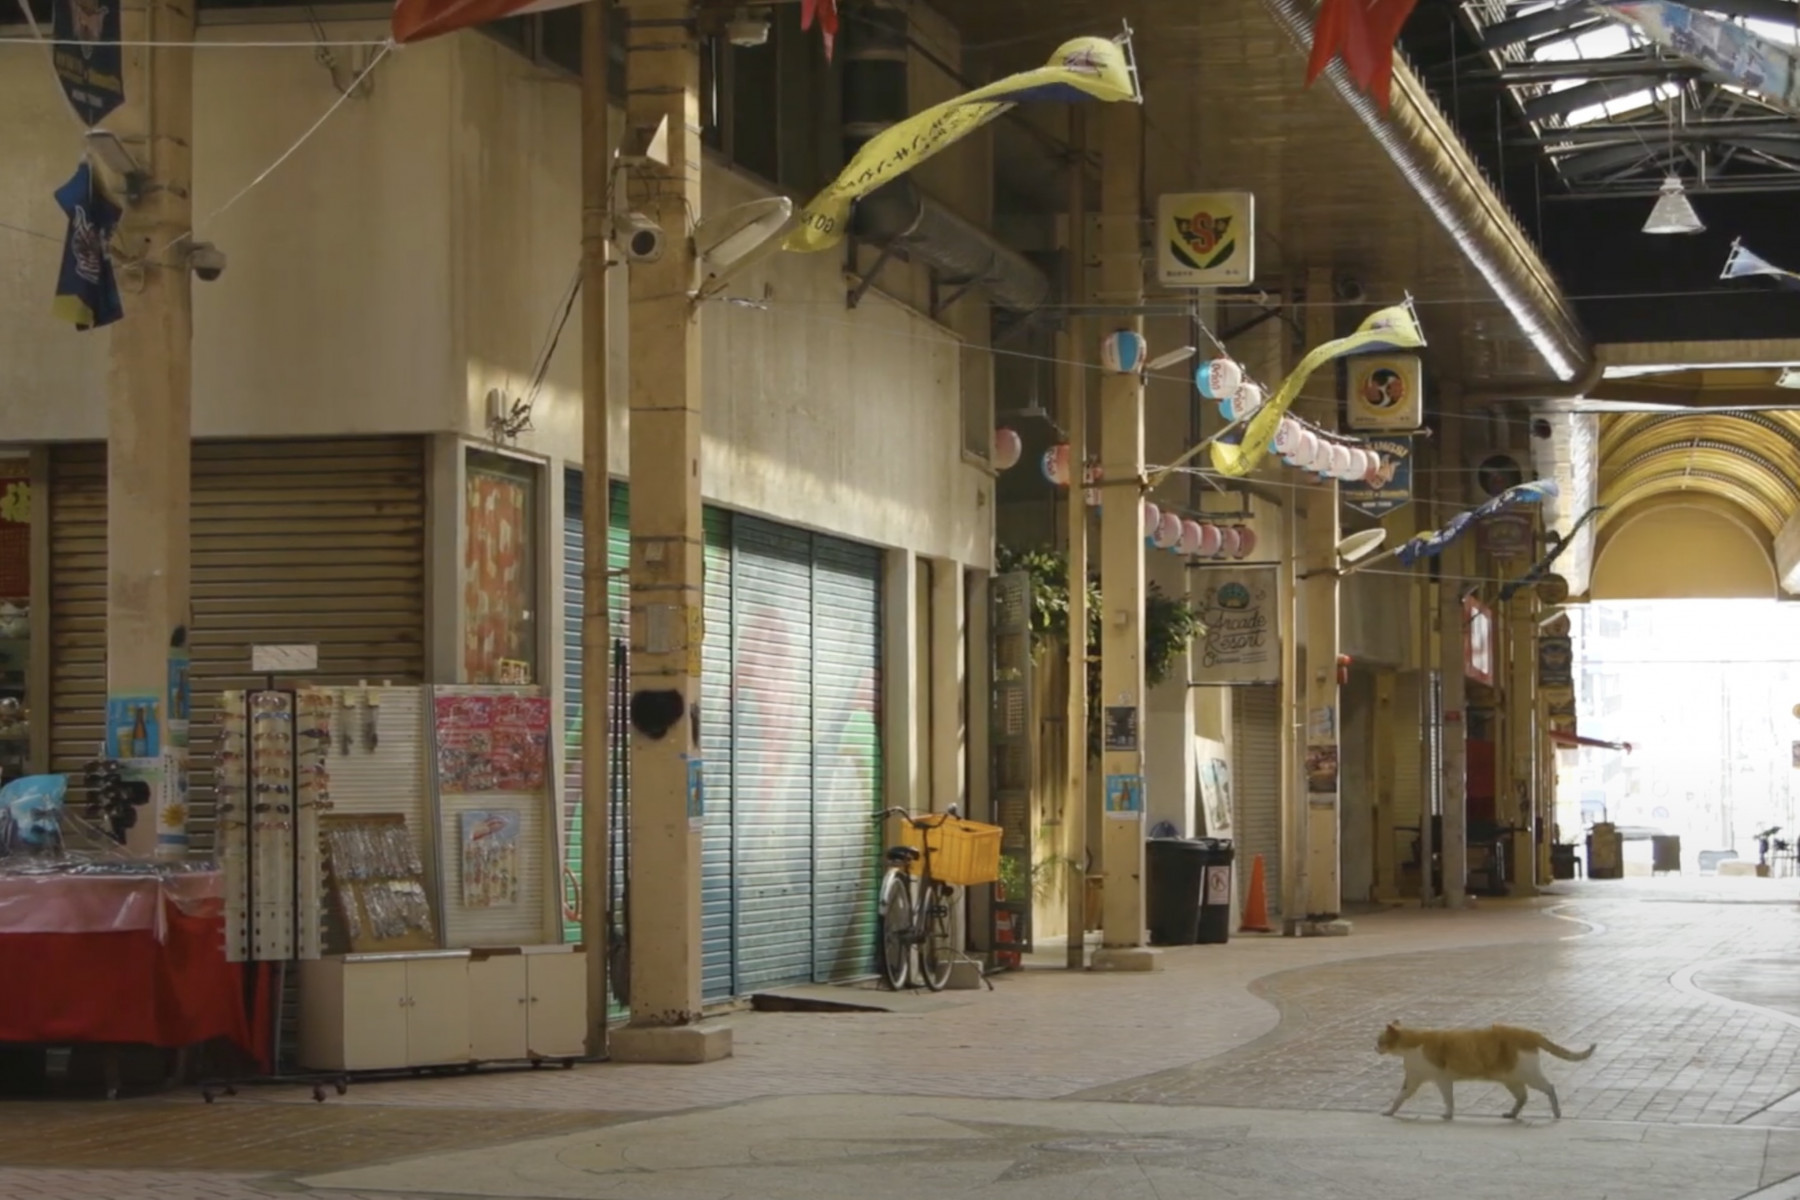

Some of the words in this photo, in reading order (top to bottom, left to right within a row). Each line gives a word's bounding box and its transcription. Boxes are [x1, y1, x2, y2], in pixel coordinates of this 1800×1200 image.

[1190, 211, 1215, 255] S
[1210, 363, 1223, 390] Orion
[1204, 609, 1267, 631] Arcade
[1203, 630, 1267, 654] Resort
